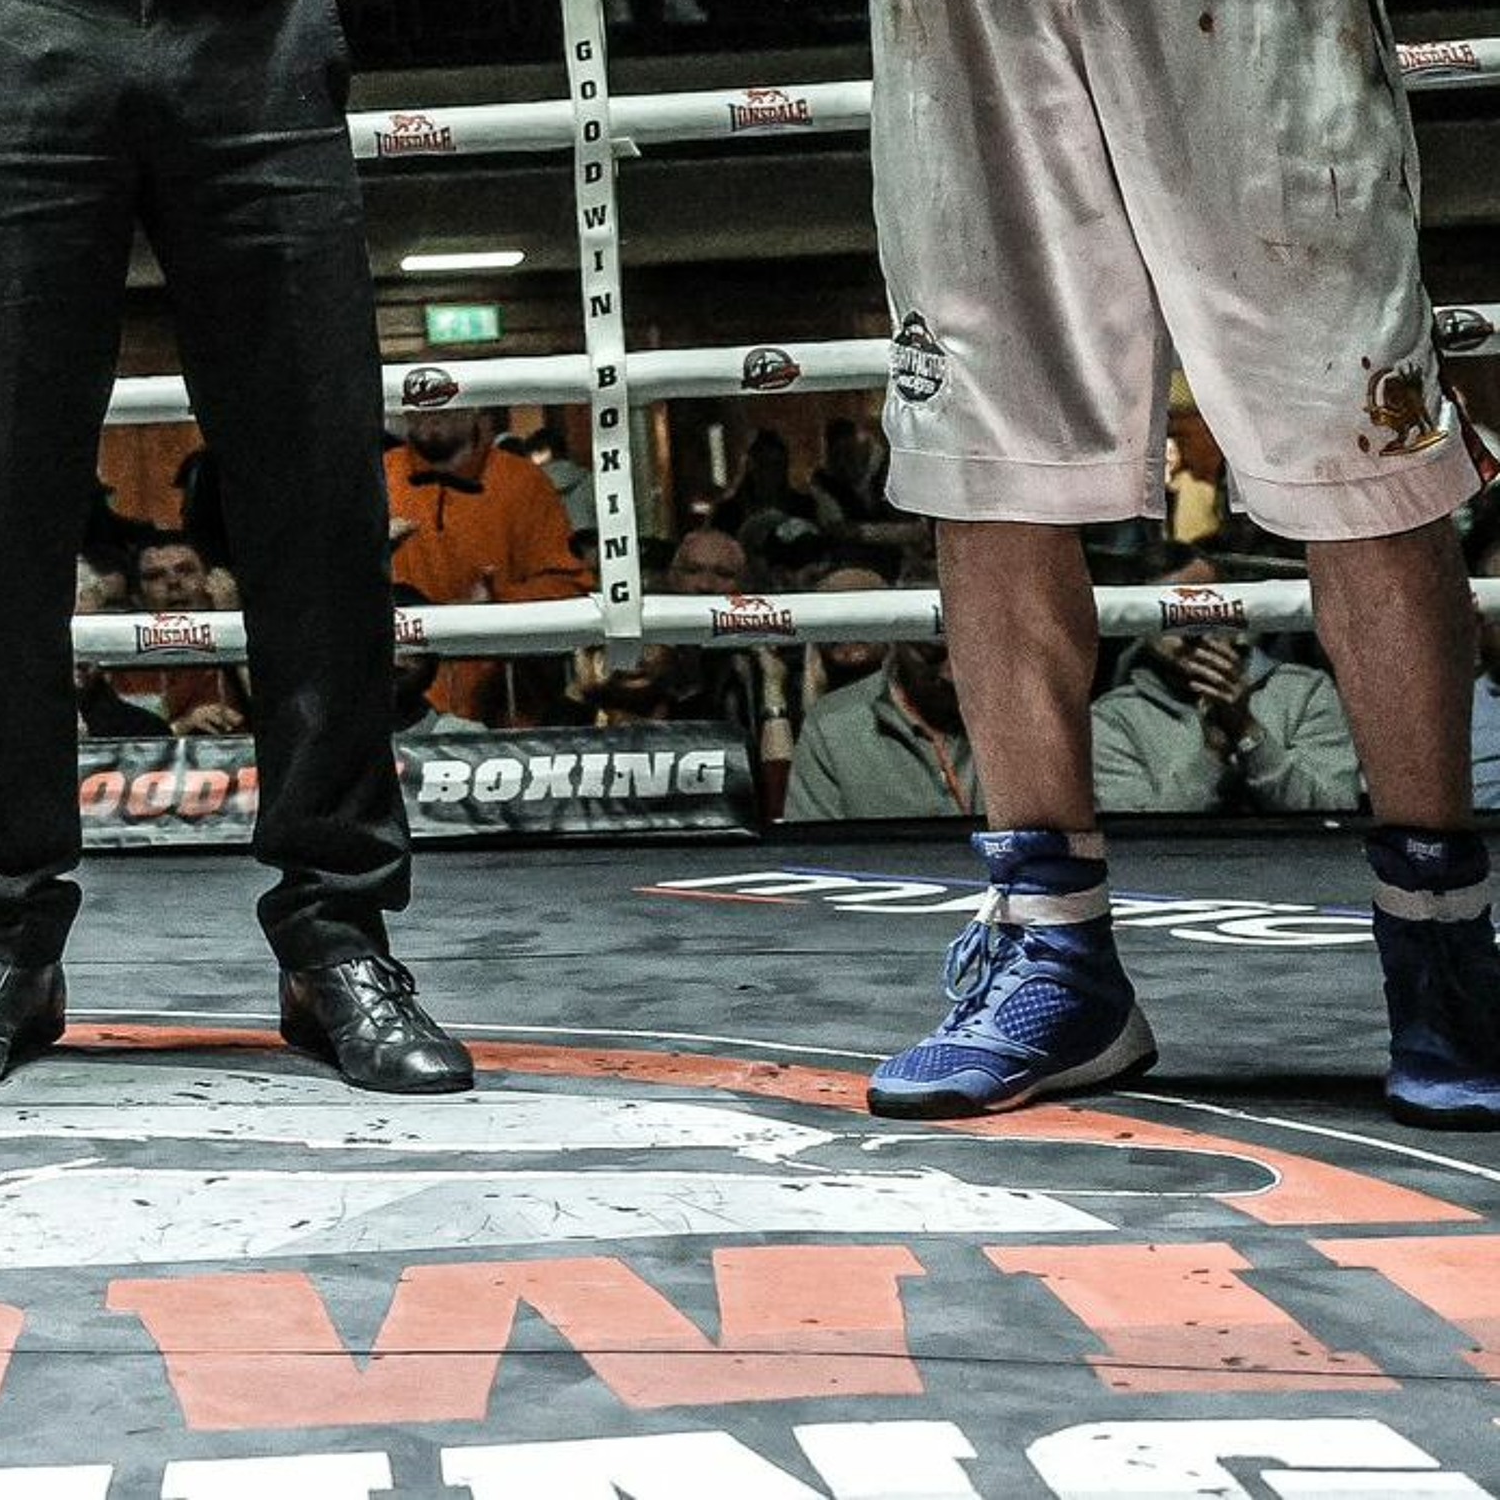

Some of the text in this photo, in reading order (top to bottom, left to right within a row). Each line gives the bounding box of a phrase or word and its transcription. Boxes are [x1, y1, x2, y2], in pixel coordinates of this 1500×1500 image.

[1395, 45, 1479, 73] ONSDALE
[728, 99, 813, 131] LONSDALE
[375, 127, 456, 156] LONSDALE
[575, 40, 612, 316] GOODWIN
[596, 366, 630, 604] BOXING
[711, 608, 796, 636] LONSDALE
[1159, 599, 1246, 632] LONSDALE
[135, 625, 217, 654] LONSDALE
[418, 750, 726, 802] BOXING
